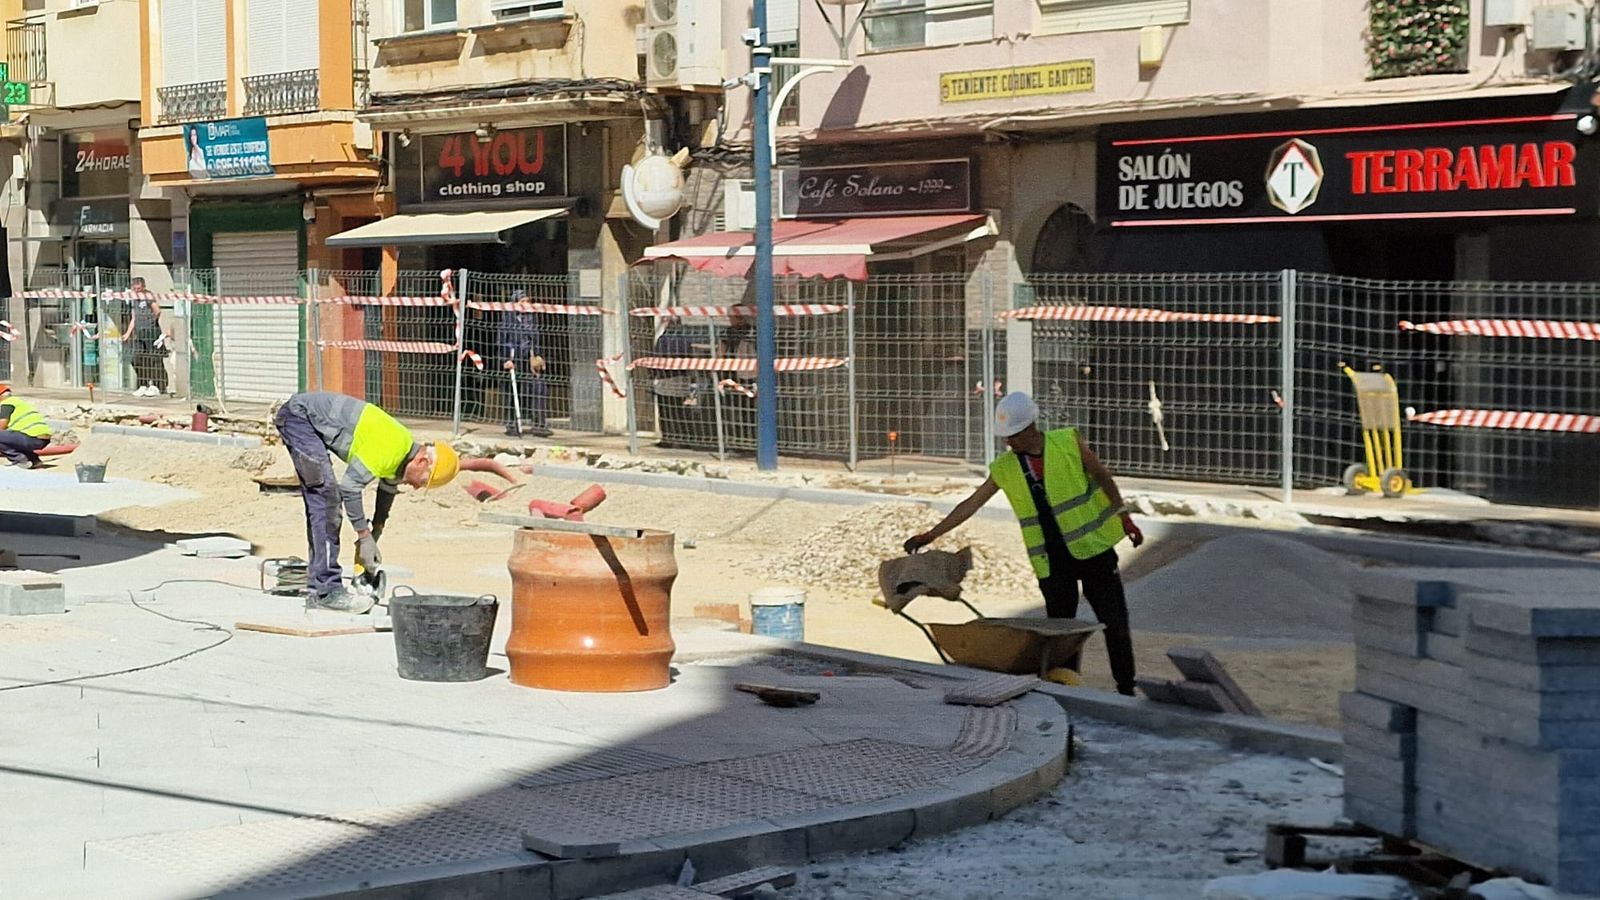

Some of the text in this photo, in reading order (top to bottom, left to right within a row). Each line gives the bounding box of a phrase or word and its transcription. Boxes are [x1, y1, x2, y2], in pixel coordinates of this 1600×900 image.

[4, 82, 26, 104] 23
[951, 66, 1093, 96] TENIENTE CORONEL GAUTIER
[439, 130, 545, 177] 4 YOU
[1118, 148, 1191, 181] SALÓN
[1345, 141, 1577, 194] TERRAMAR
[439, 180, 545, 196] clothing shop
[799, 176, 837, 207] Café
[841, 174, 904, 197] Solano
[1118, 181, 1244, 211] DE JUEGOS
[1283, 161, 1304, 198] T
